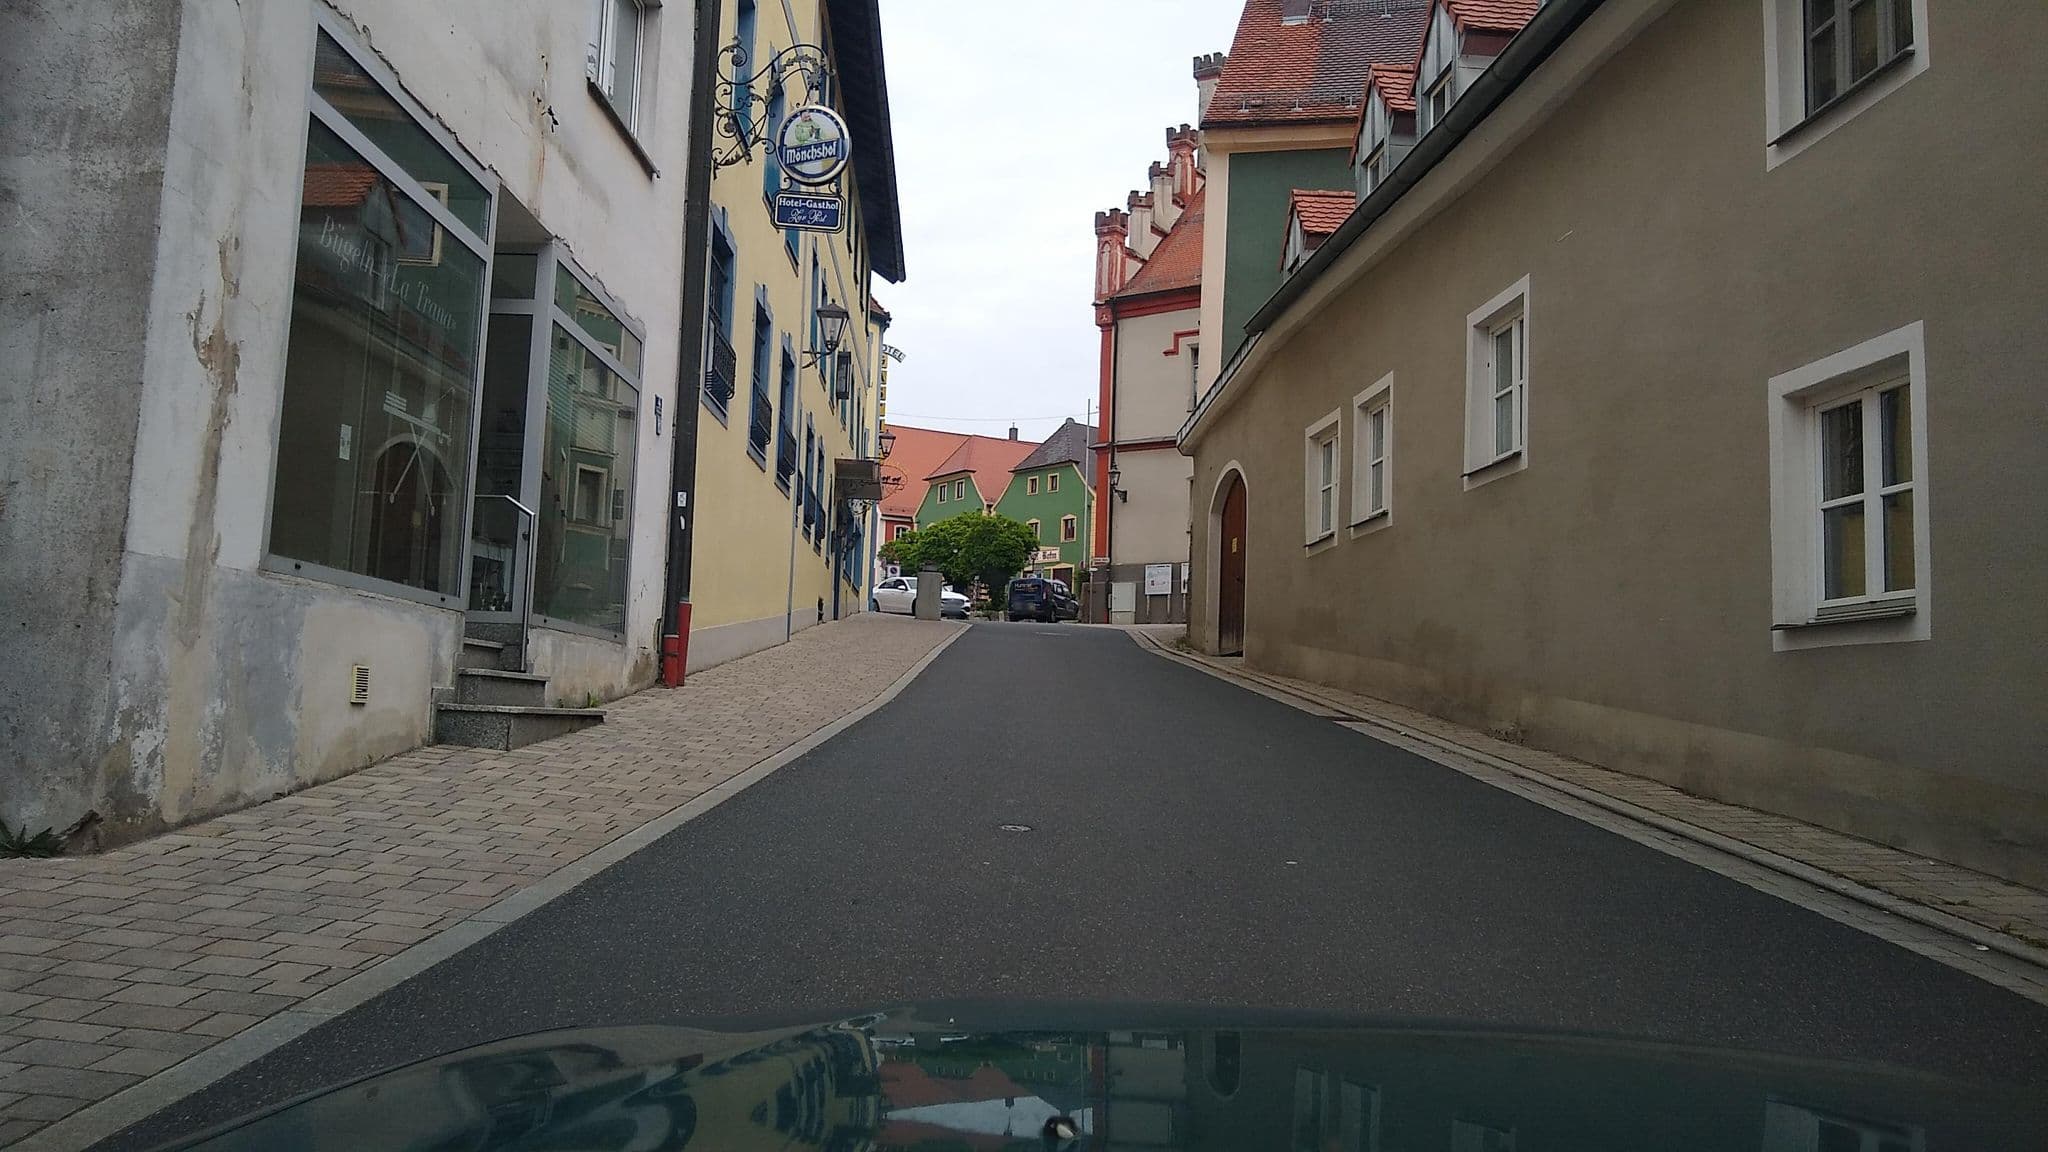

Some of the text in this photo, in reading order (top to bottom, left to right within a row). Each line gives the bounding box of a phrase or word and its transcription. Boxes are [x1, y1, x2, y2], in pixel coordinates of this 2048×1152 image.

[786, 141, 837, 165] Mönchshof
[779, 197, 839, 210] Hotel-Gasthof
[788, 208, 828, 224] Zur Post
[882, 343, 905, 362] OTEL
